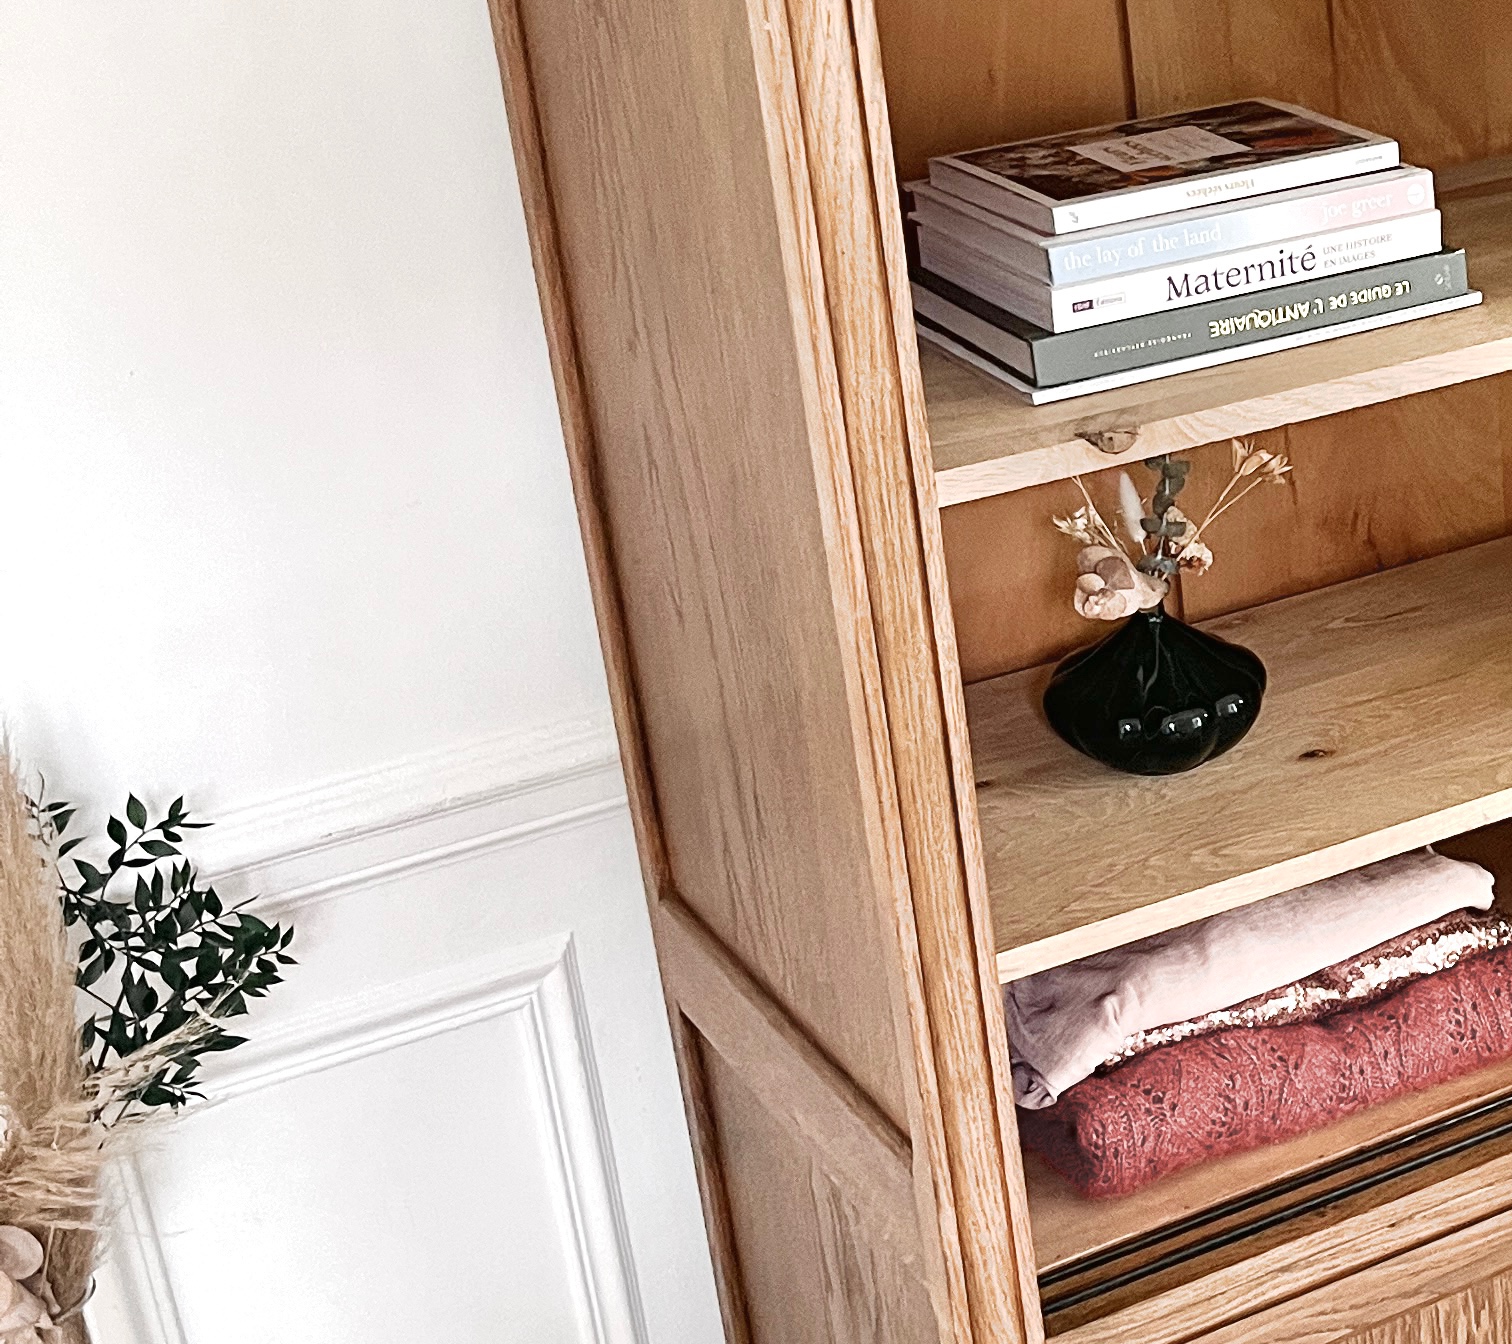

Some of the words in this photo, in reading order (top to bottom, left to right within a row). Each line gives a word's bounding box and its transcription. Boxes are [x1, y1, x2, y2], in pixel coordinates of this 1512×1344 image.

[1320, 196, 1347, 225] joe
[1351, 194, 1394, 218] greer
[1064, 251, 1092, 271] the
[1096, 245, 1120, 266] lay
[1127, 237, 1146, 258] of
[1152, 233, 1179, 252] the
[1184, 222, 1222, 247] land
[1322, 243, 1344, 255] UNE
[1346, 233, 1393, 251] HISTOIRE
[1323, 258, 1337, 269] EN
[1338, 250, 1376, 265] IMAGES
[1166, 244, 1317, 301] Maternité
[1350, 286, 1392, 304] GUIDE
[1395, 280, 1411, 296] LE
[1328, 294, 1347, 311] DE
